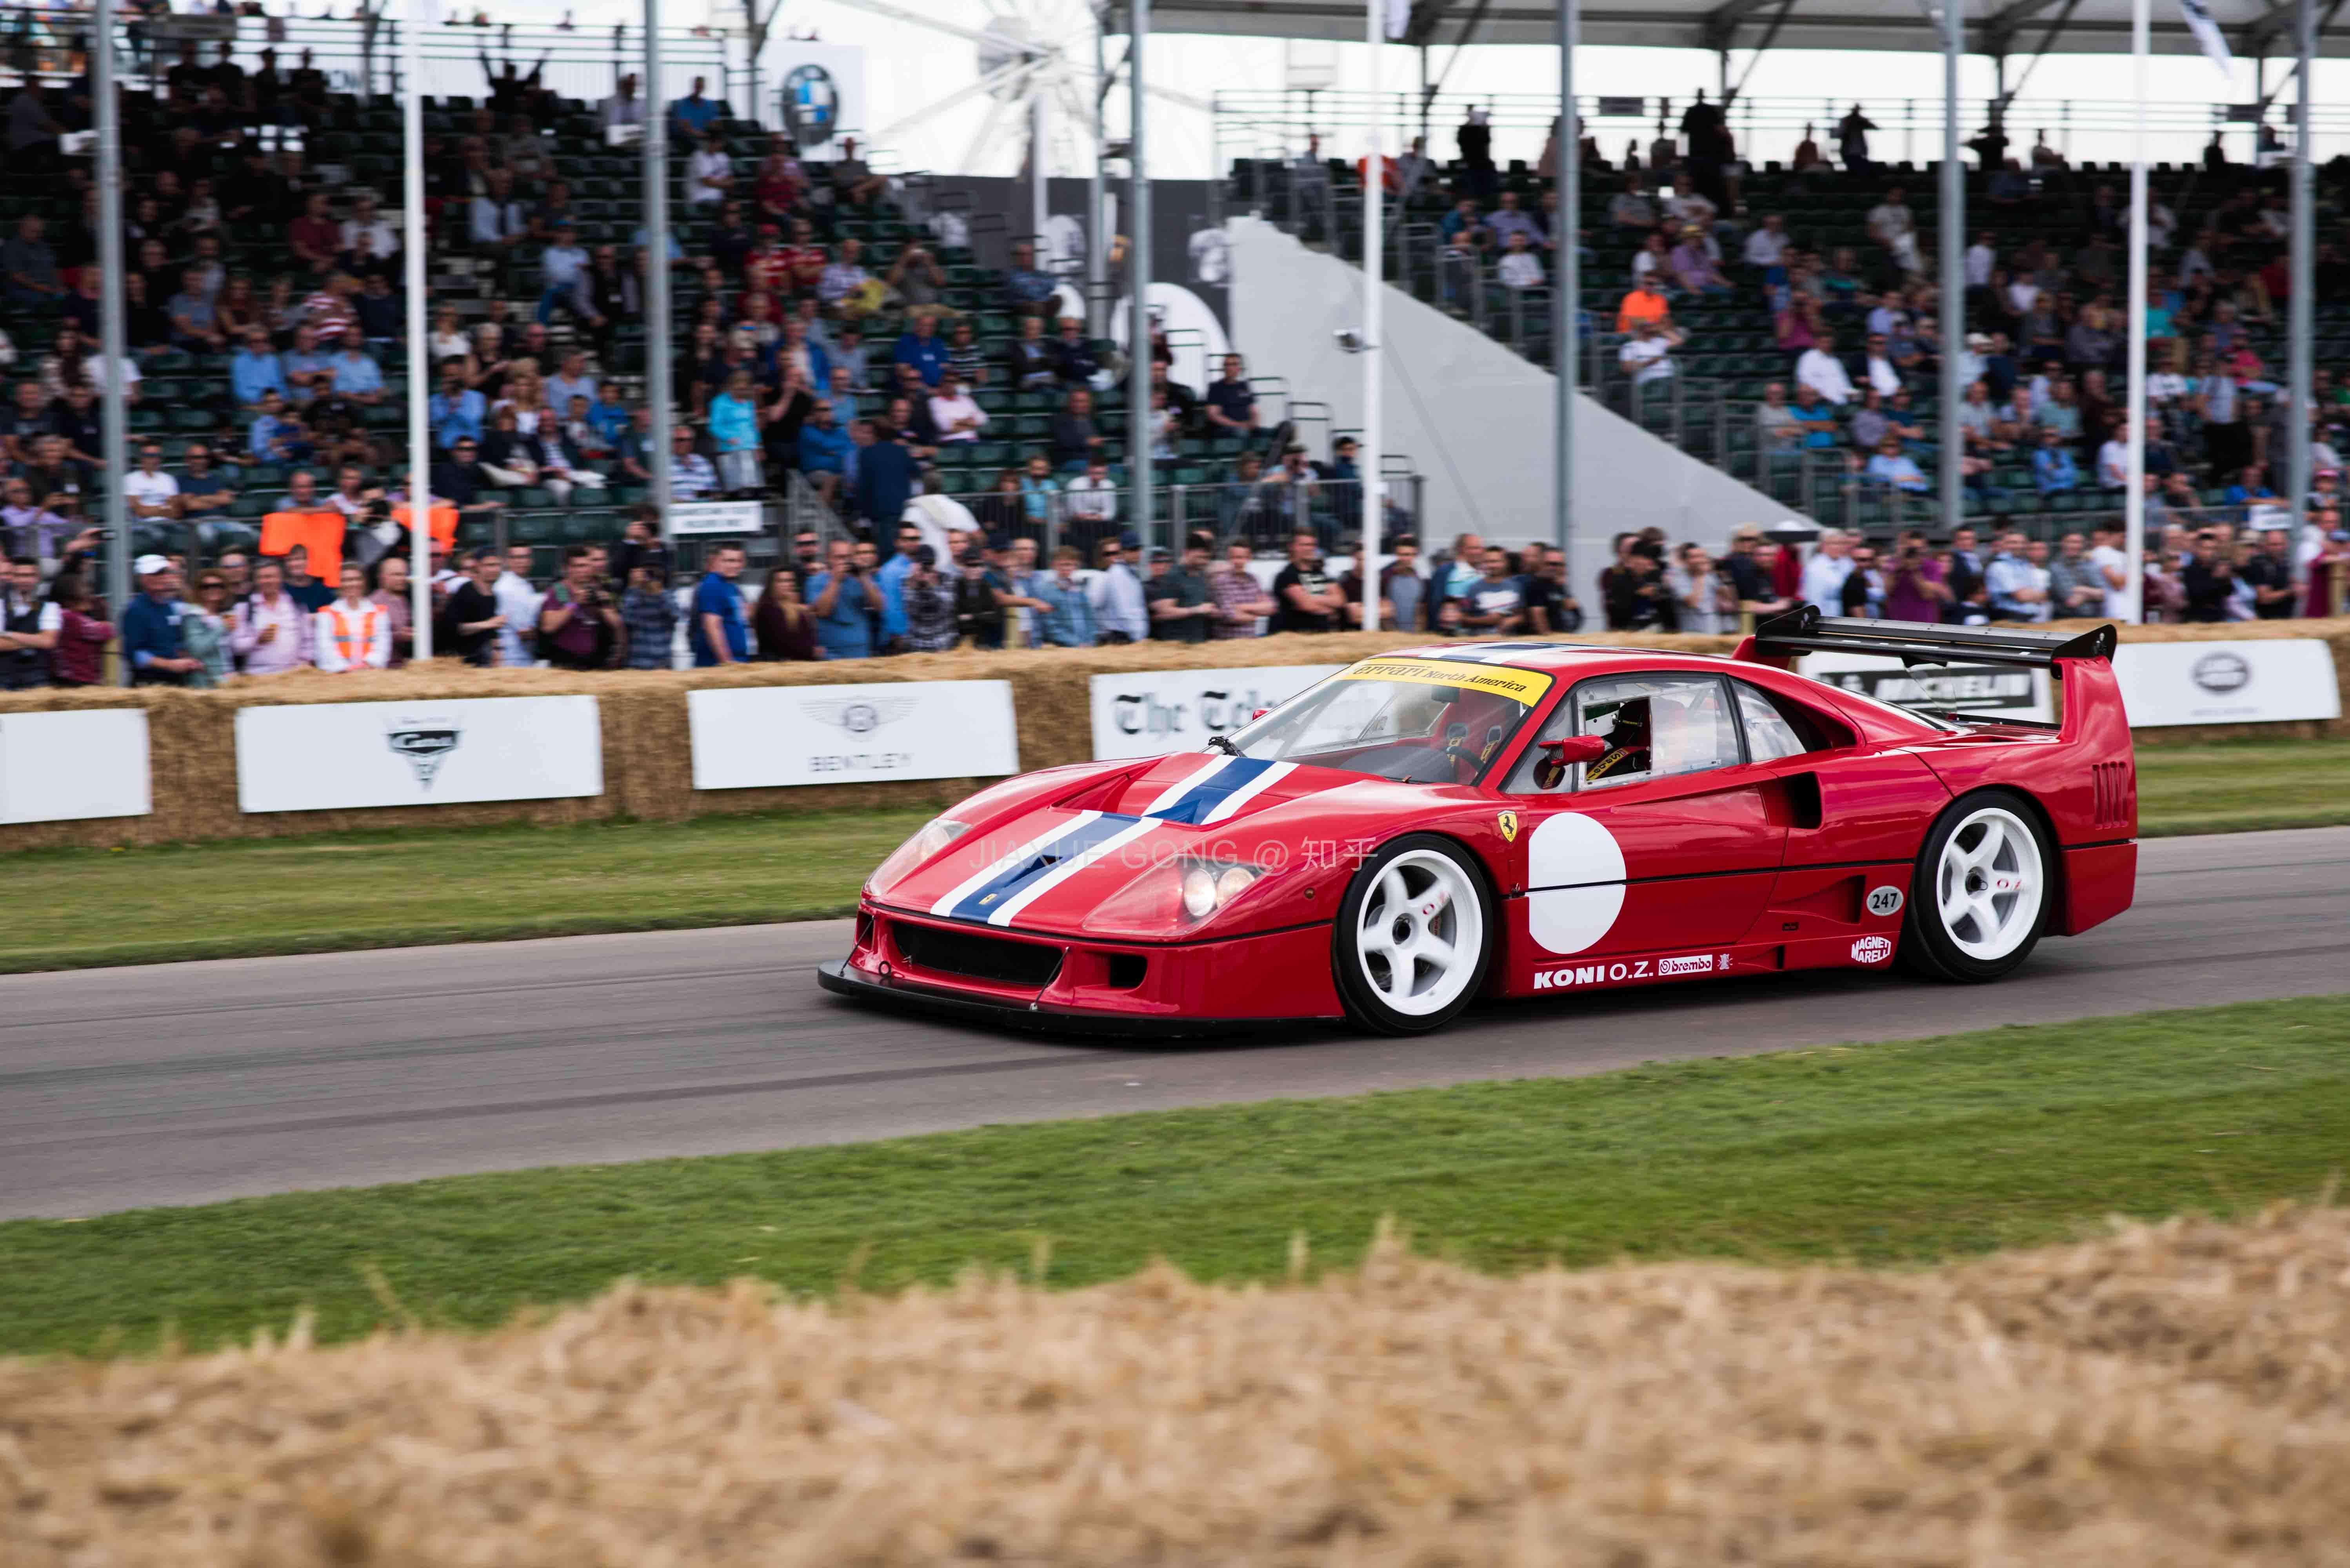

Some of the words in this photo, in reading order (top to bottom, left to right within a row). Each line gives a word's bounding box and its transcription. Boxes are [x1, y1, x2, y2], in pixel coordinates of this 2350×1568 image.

[1421, 671, 1467, 681] North
[1464, 675, 1527, 692] America
[1872, 893, 1897, 909] 247
[1852, 936, 1891, 952] MAGNETI
[1851, 949, 1891, 963] MARELLI
[1534, 965, 1605, 989] KONI
[1610, 961, 1654, 980] O.Z.
[1672, 958, 1711, 972] brembo
